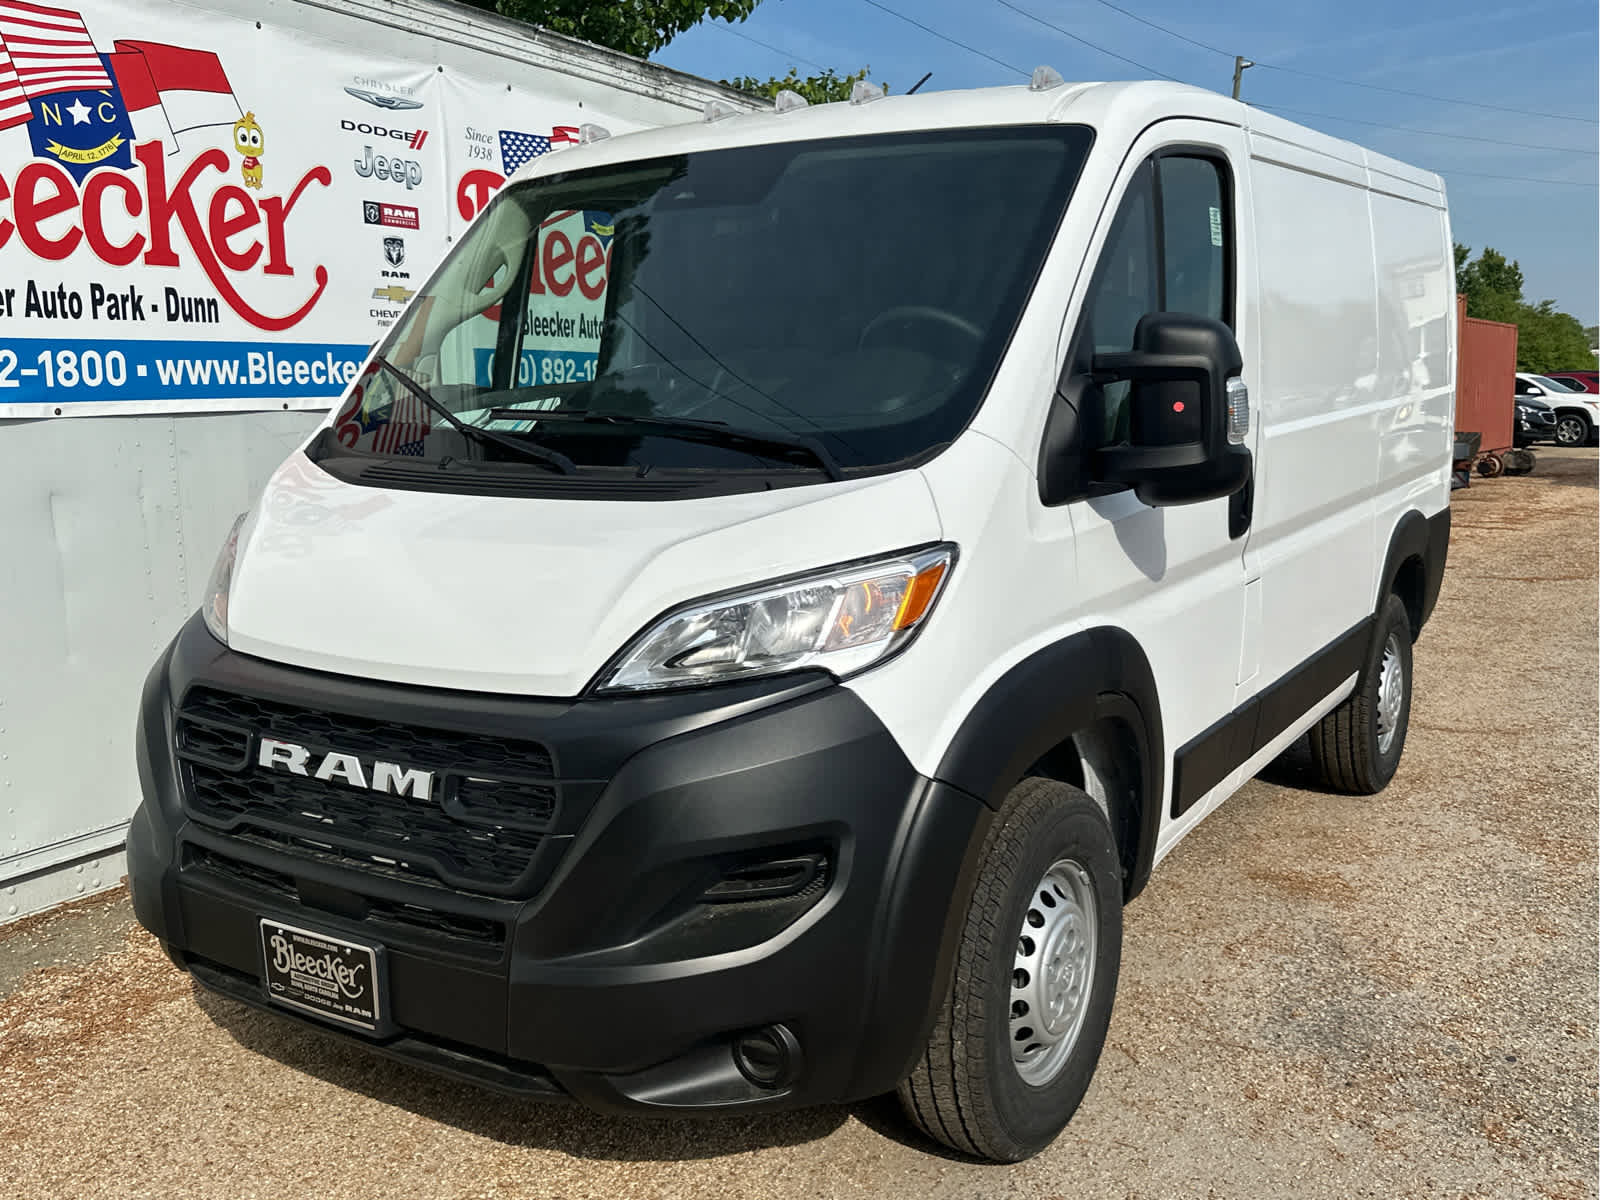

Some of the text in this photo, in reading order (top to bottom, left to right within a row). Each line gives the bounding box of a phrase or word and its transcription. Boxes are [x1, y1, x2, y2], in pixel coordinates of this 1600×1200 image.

[353, 76, 415, 97] CHRYSLER
[41, 101, 117, 126] N C
[341, 119, 417, 143] DODGE
[465, 126, 493, 144] Since
[60, 148, 85, 161] APRIL
[98, 143, 114, 157] 1776
[467, 144, 493, 161] 1938
[353, 145, 423, 190] Jeep
[383, 207, 416, 219] RAM
[0, 141, 332, 331] ecker
[381, 270, 410, 279] RAM
[25, 280, 83, 319] Auto
[90, 283, 145, 321] Park
[166, 286, 219, 323] Dunn
[0, 349, 364, 388] 2-1800 www.Bleecke
[259, 738, 435, 801] RAM
[344, 1004, 371, 1018] RAM
